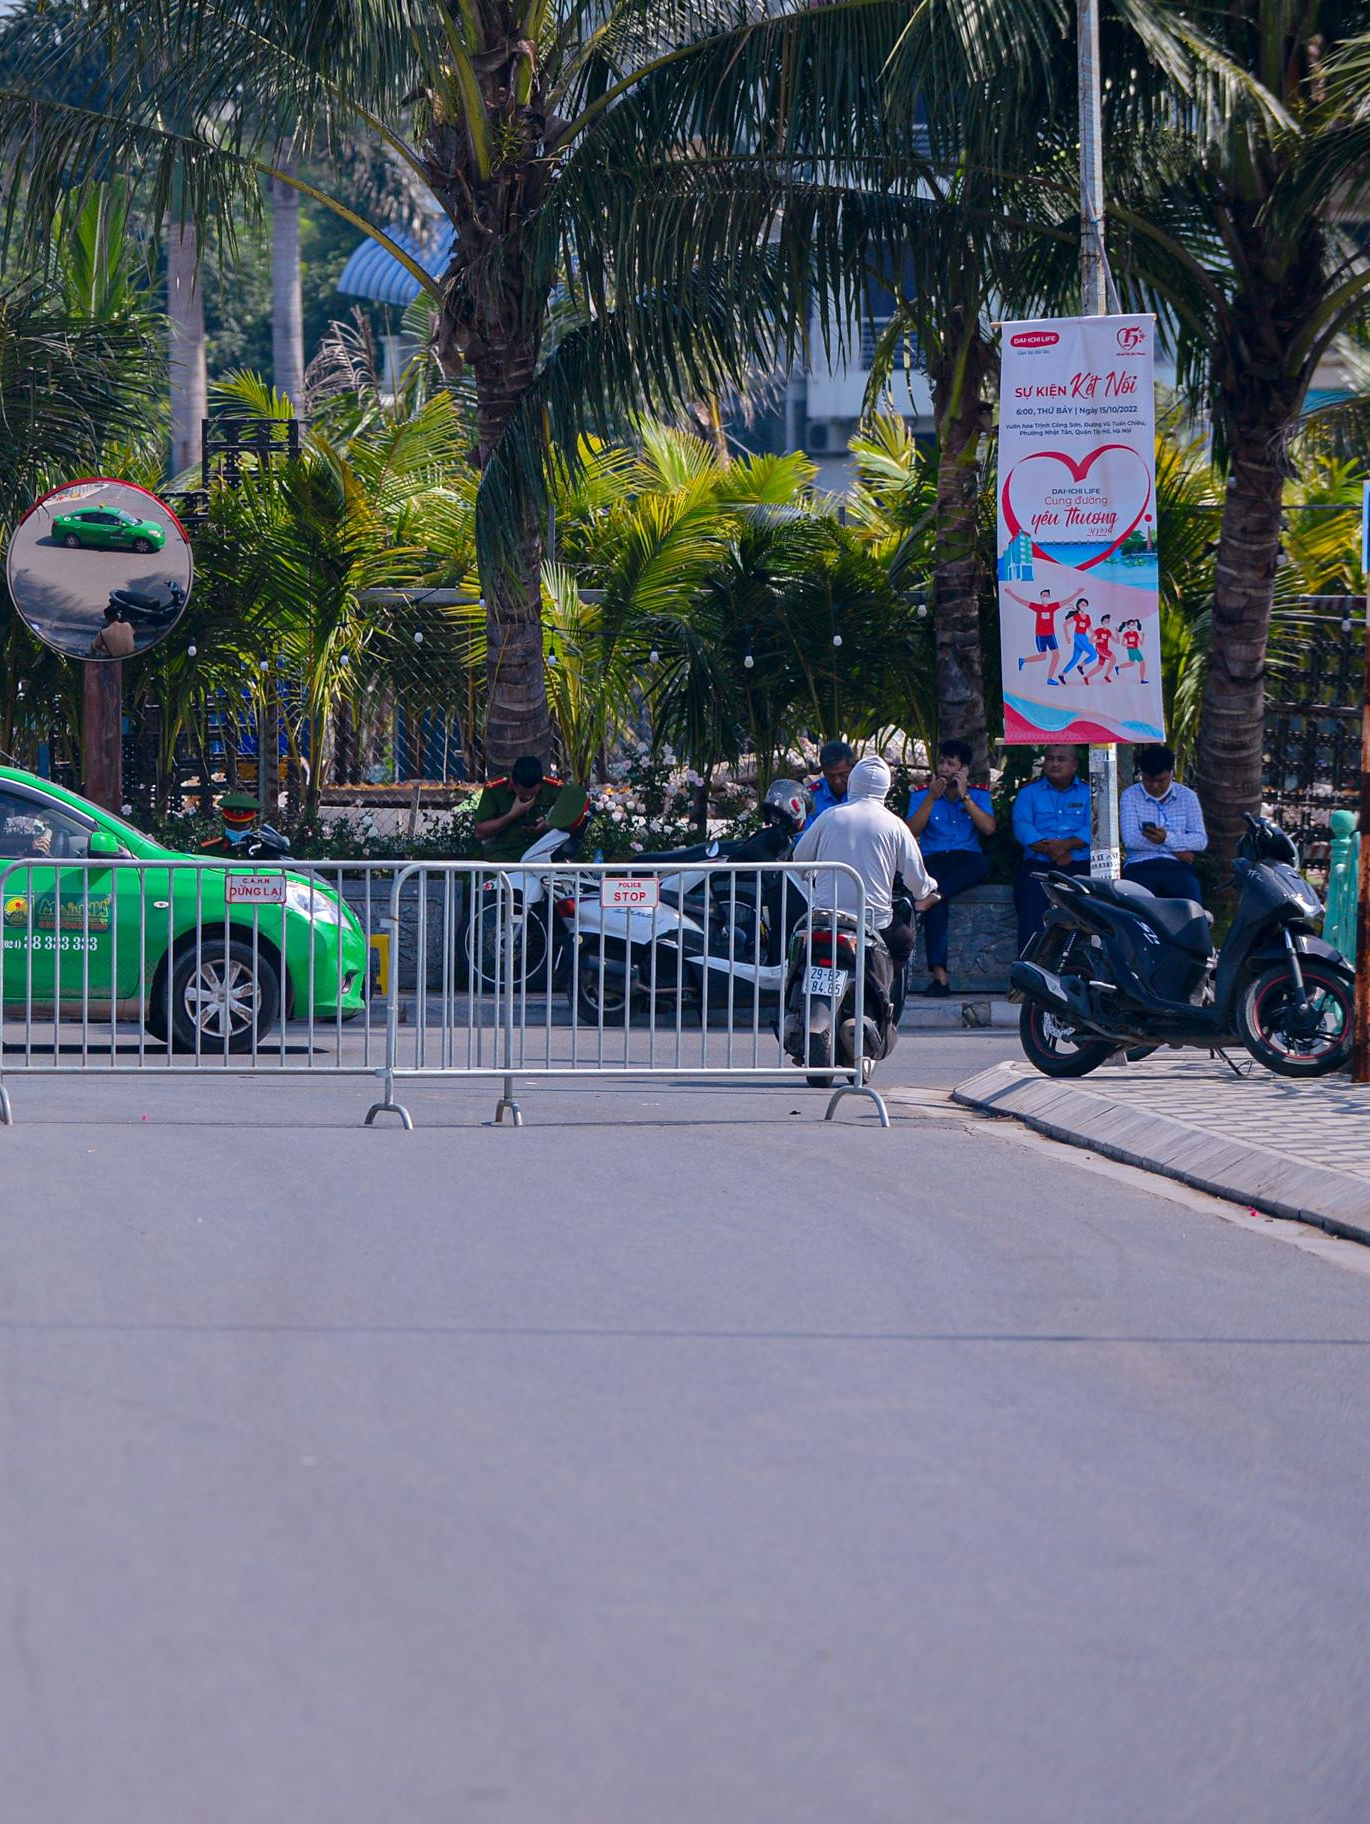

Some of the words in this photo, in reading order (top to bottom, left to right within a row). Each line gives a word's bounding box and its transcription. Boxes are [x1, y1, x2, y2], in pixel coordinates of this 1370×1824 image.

[1015, 385, 1033, 400] SỰ
[1036, 384, 1067, 399] KIỆN
[1070, 372, 1102, 400] Kết
[1105, 370, 1138, 398] Nối
[1016, 408, 1036, 416] 6:00,
[1038, 405, 1054, 415] THỨ
[1056, 405, 1072, 414] BẢY
[1080, 407, 1098, 416] Ngày
[1099, 405, 1138, 414] 15/10/2022
[1044, 496, 1072, 506] Cung
[1075, 495, 1108, 506] đường
[1031, 510, 1059, 534] yêu
[230, 885, 261, 896] DỪNG
[264, 888, 282, 897] LẠI
[614, 892, 646, 901] STOP
